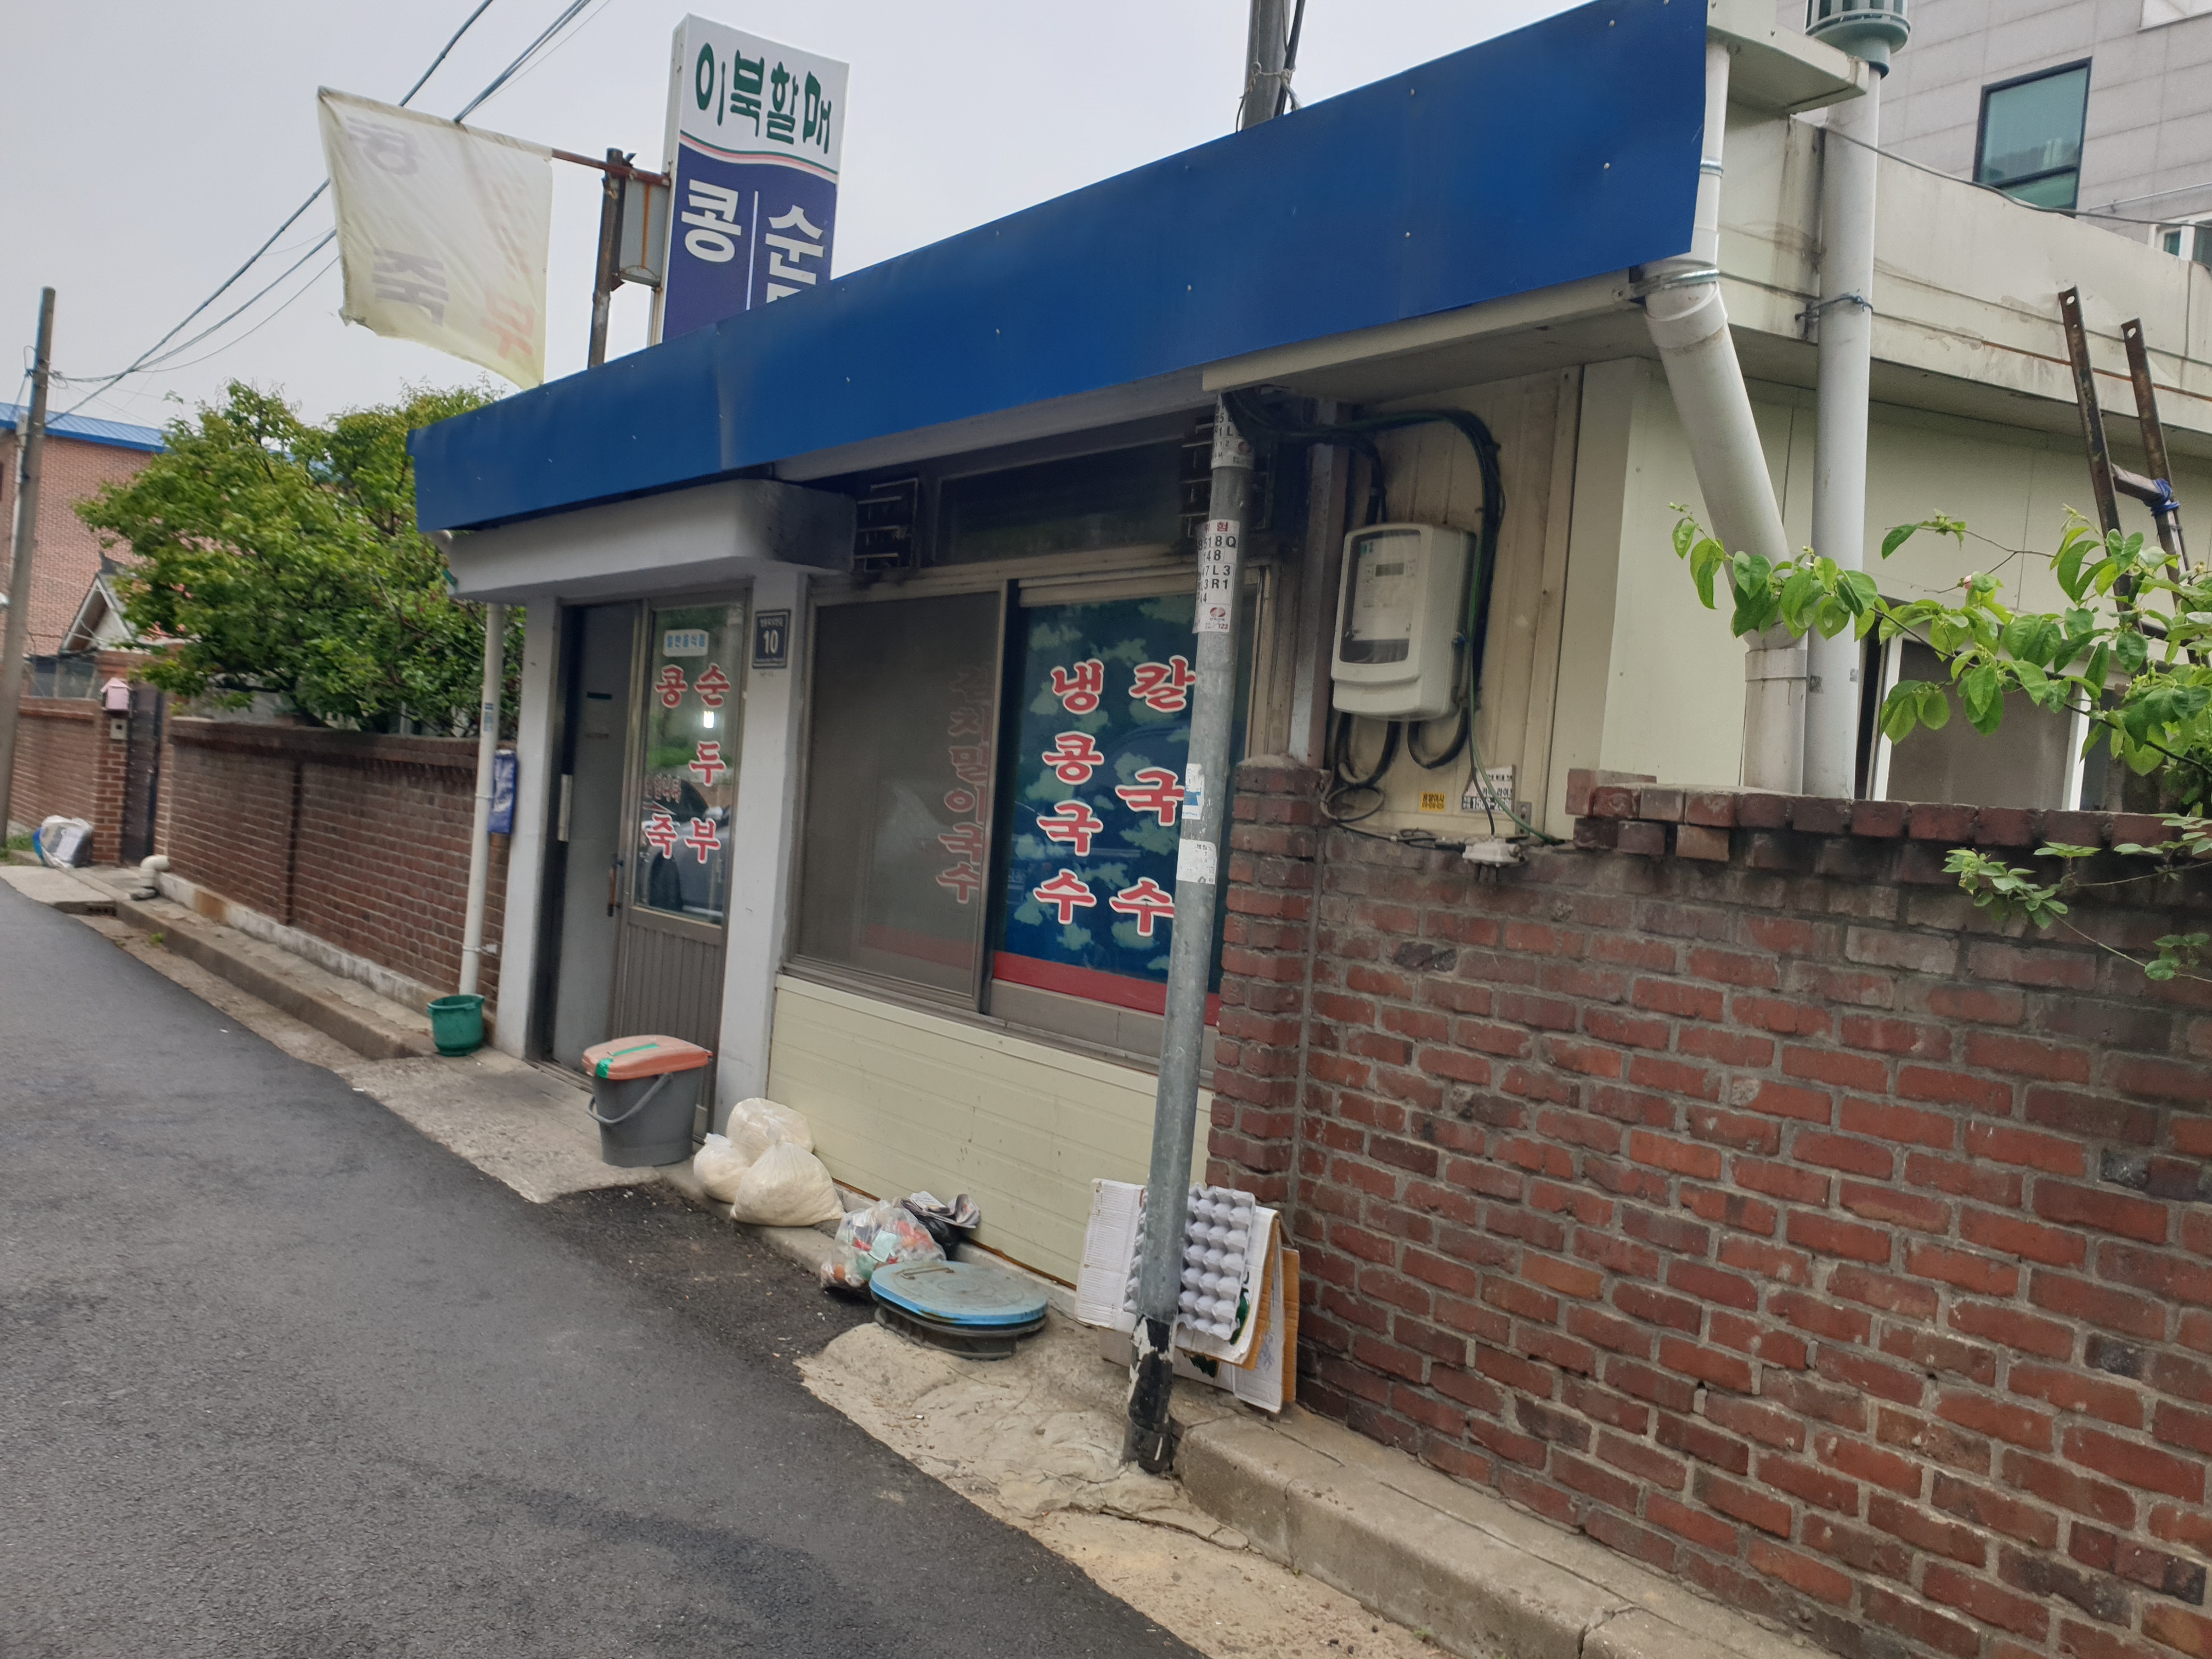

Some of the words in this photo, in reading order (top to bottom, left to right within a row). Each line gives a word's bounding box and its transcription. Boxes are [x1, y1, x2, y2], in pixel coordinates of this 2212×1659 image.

[695, 42, 832, 155] 이북할매
[681, 178, 742, 263] 콩
[763, 629, 779, 654] 10
[1032, 658, 1105, 925] 냉콩국수
[1108, 655, 1197, 937] 칼국수
